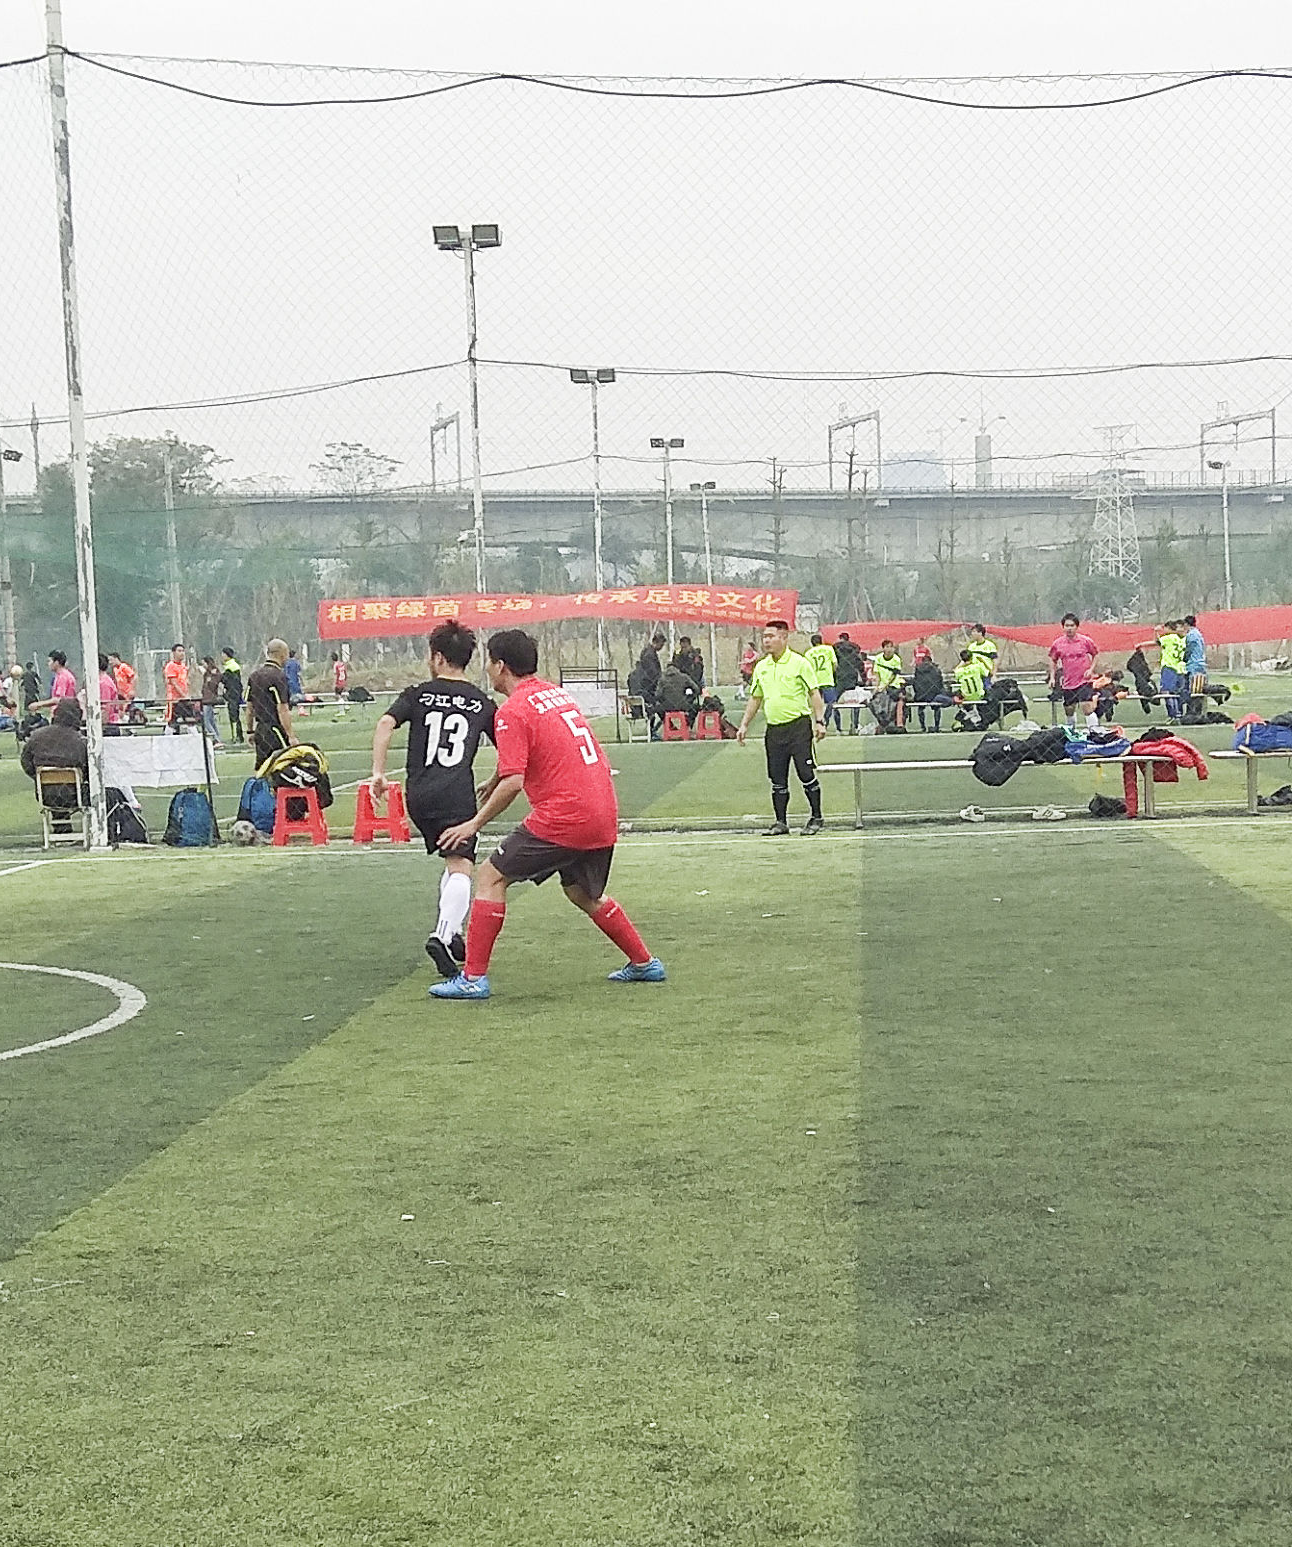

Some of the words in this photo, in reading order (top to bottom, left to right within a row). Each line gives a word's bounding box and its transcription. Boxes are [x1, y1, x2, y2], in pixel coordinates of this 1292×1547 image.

[812, 654, 827, 672] 12
[963, 676, 979, 694] 11
[424, 710, 469, 768] 13
[560, 709, 599, 765] 5
